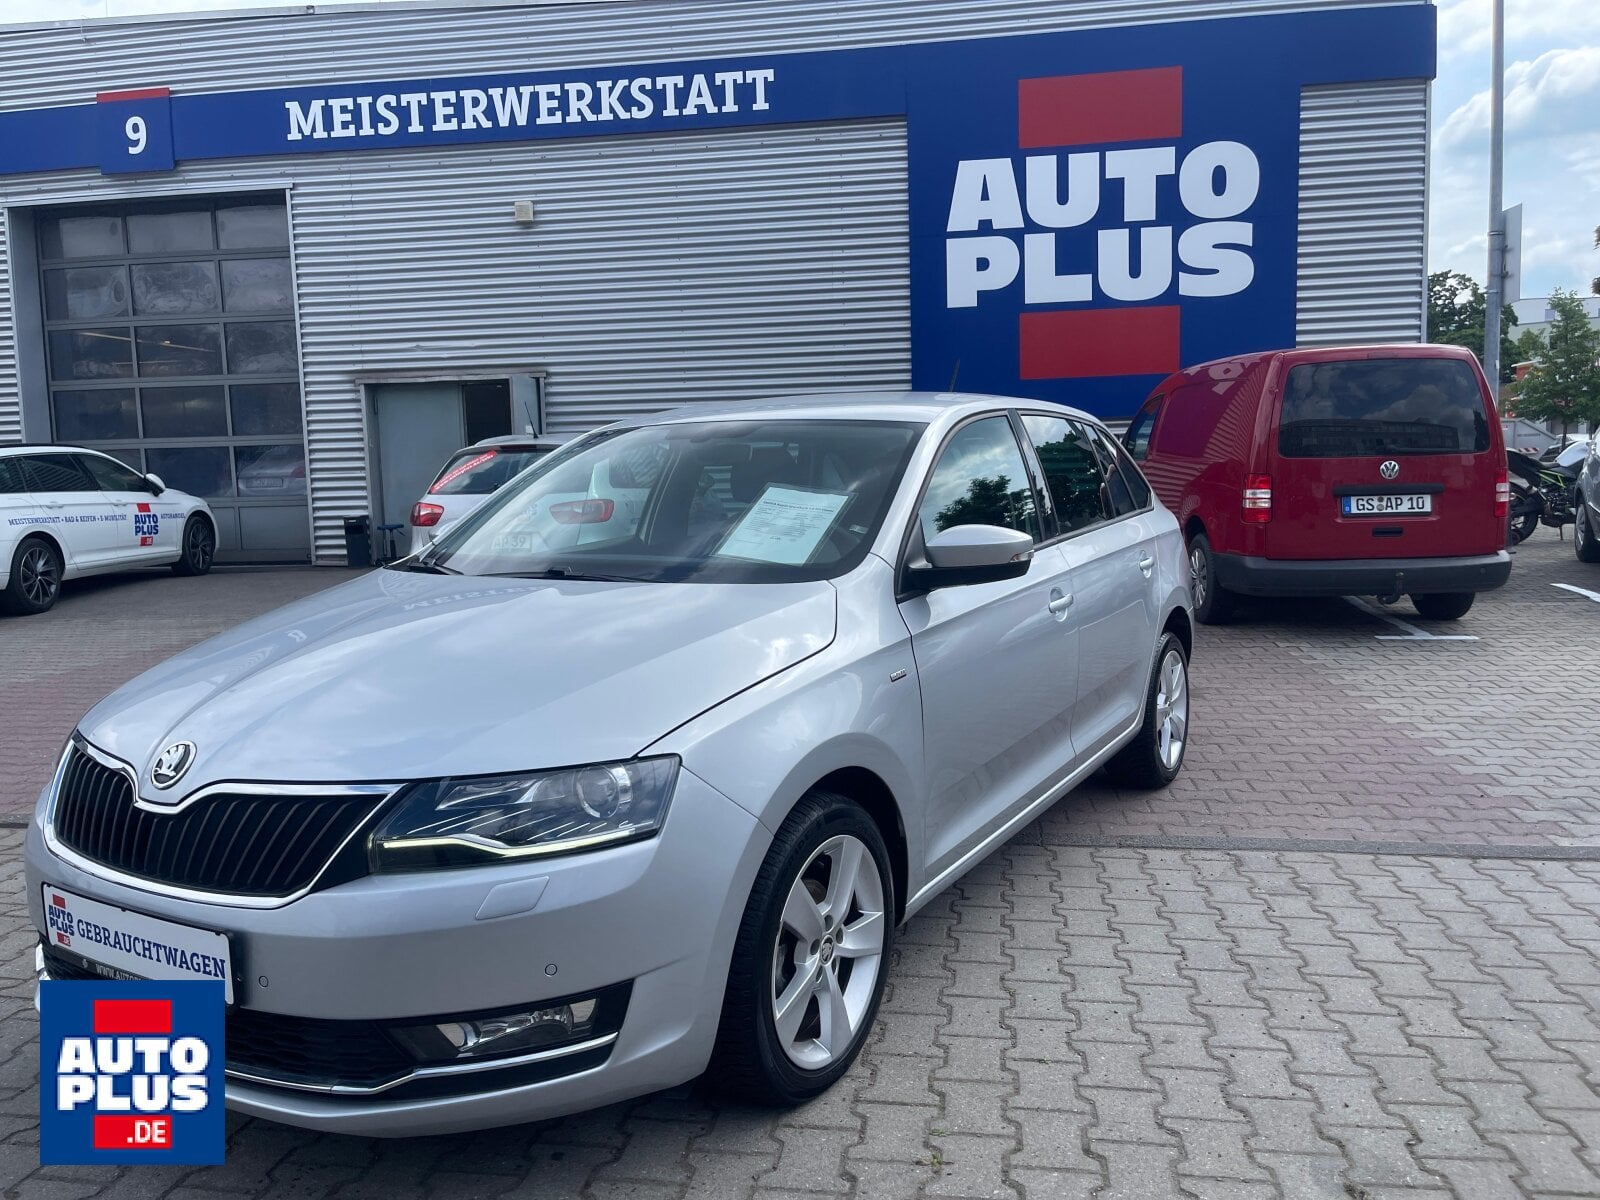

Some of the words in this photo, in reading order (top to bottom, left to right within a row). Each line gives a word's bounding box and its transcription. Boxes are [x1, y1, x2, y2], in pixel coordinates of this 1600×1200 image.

[284, 68, 775, 141] MEISTERWERKSTATT
[125, 116, 147, 155] 9
[946, 140, 1260, 232] AUTO
[946, 221, 1255, 308] PLUS
[1356, 498, 1375, 512] GS
[1385, 497, 1403, 511] AP
[1407, 496, 1425, 510] 10
[8, 516, 60, 526] MEISTERWERKSTATT
[134, 513, 159, 525] AUTO
[134, 525, 159, 536] PLUS
[511, 535, 527, 548] 39
[49, 904, 73, 924] AUTO
[50, 916, 75, 937] PLUS
[77, 918, 226, 979] GEBRAUCHTWAGEN
